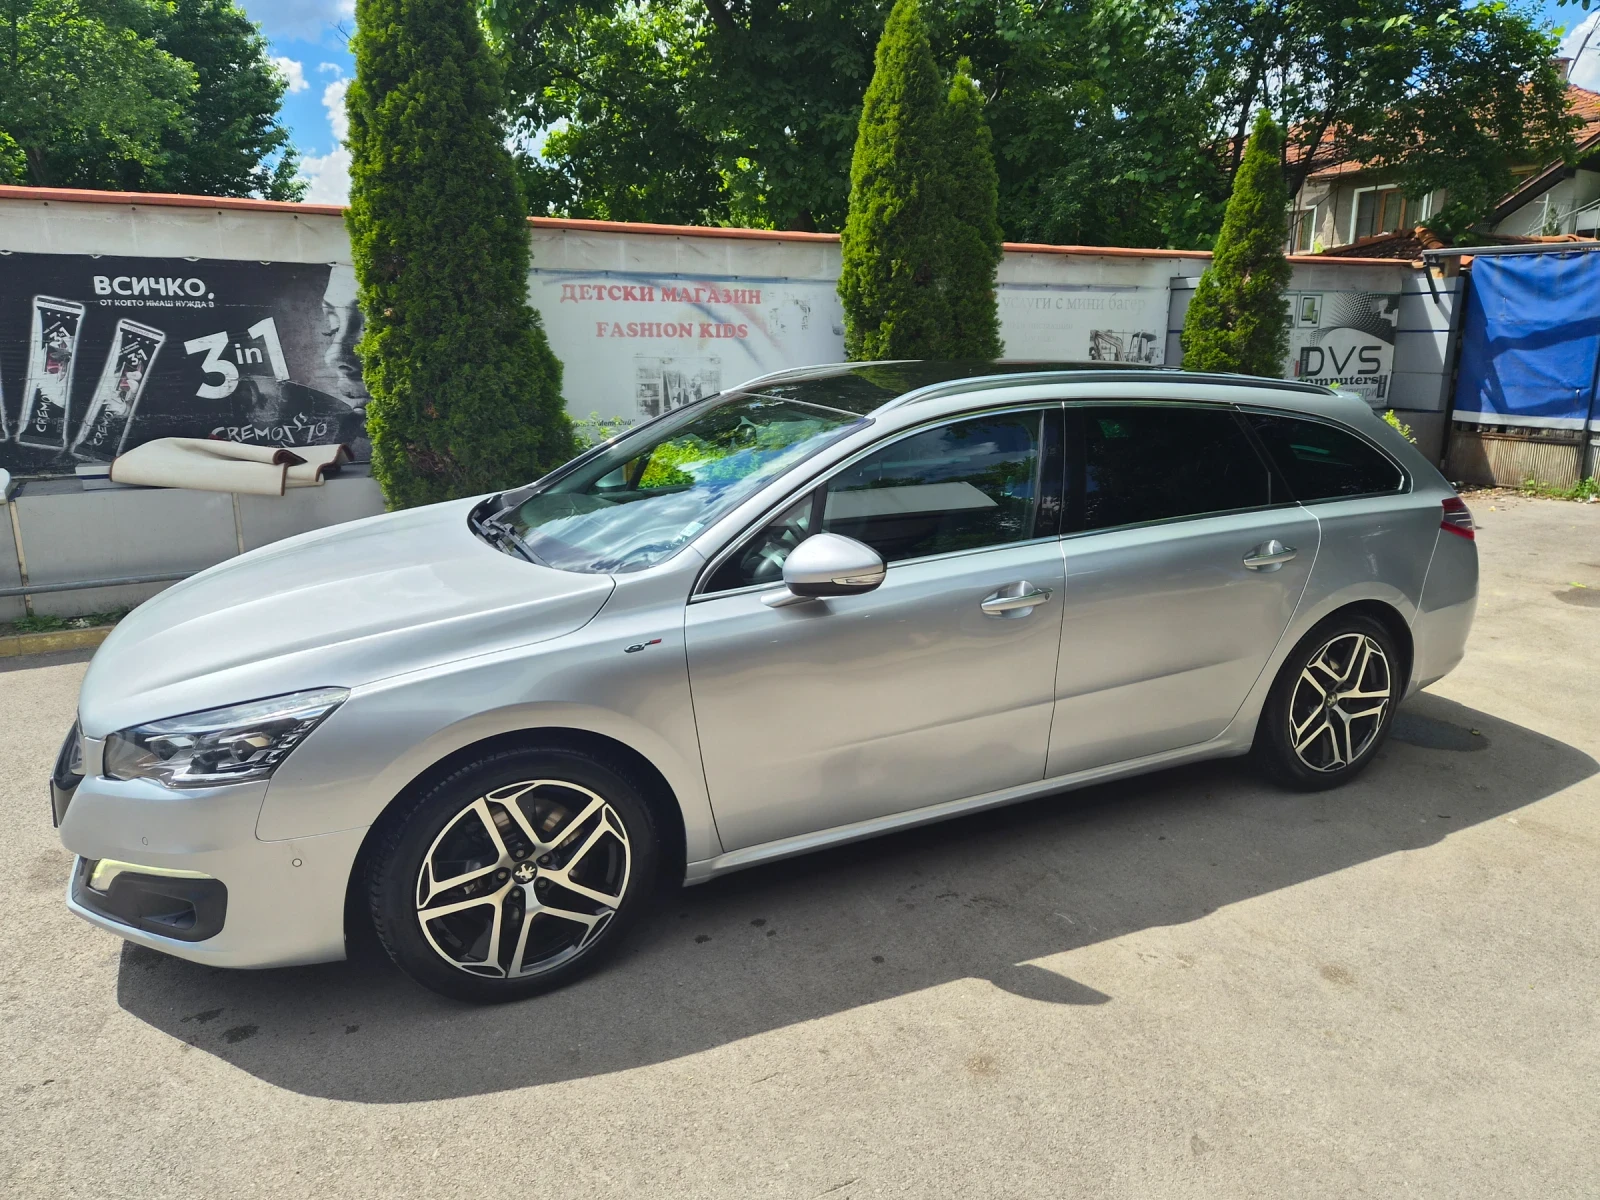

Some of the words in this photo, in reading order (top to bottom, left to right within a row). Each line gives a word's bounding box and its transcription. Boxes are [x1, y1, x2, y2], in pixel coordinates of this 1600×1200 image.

[93, 275, 215, 300] ВСИЧКО.
[560, 284, 655, 304] ДЕТСКИ
[660, 286, 762, 305] МАГАЗИН
[114, 299, 144, 307] КОЕТО
[596, 321, 694, 338] FASHION
[698, 323, 749, 339] KIDS
[1299, 345, 1382, 377] DVS
